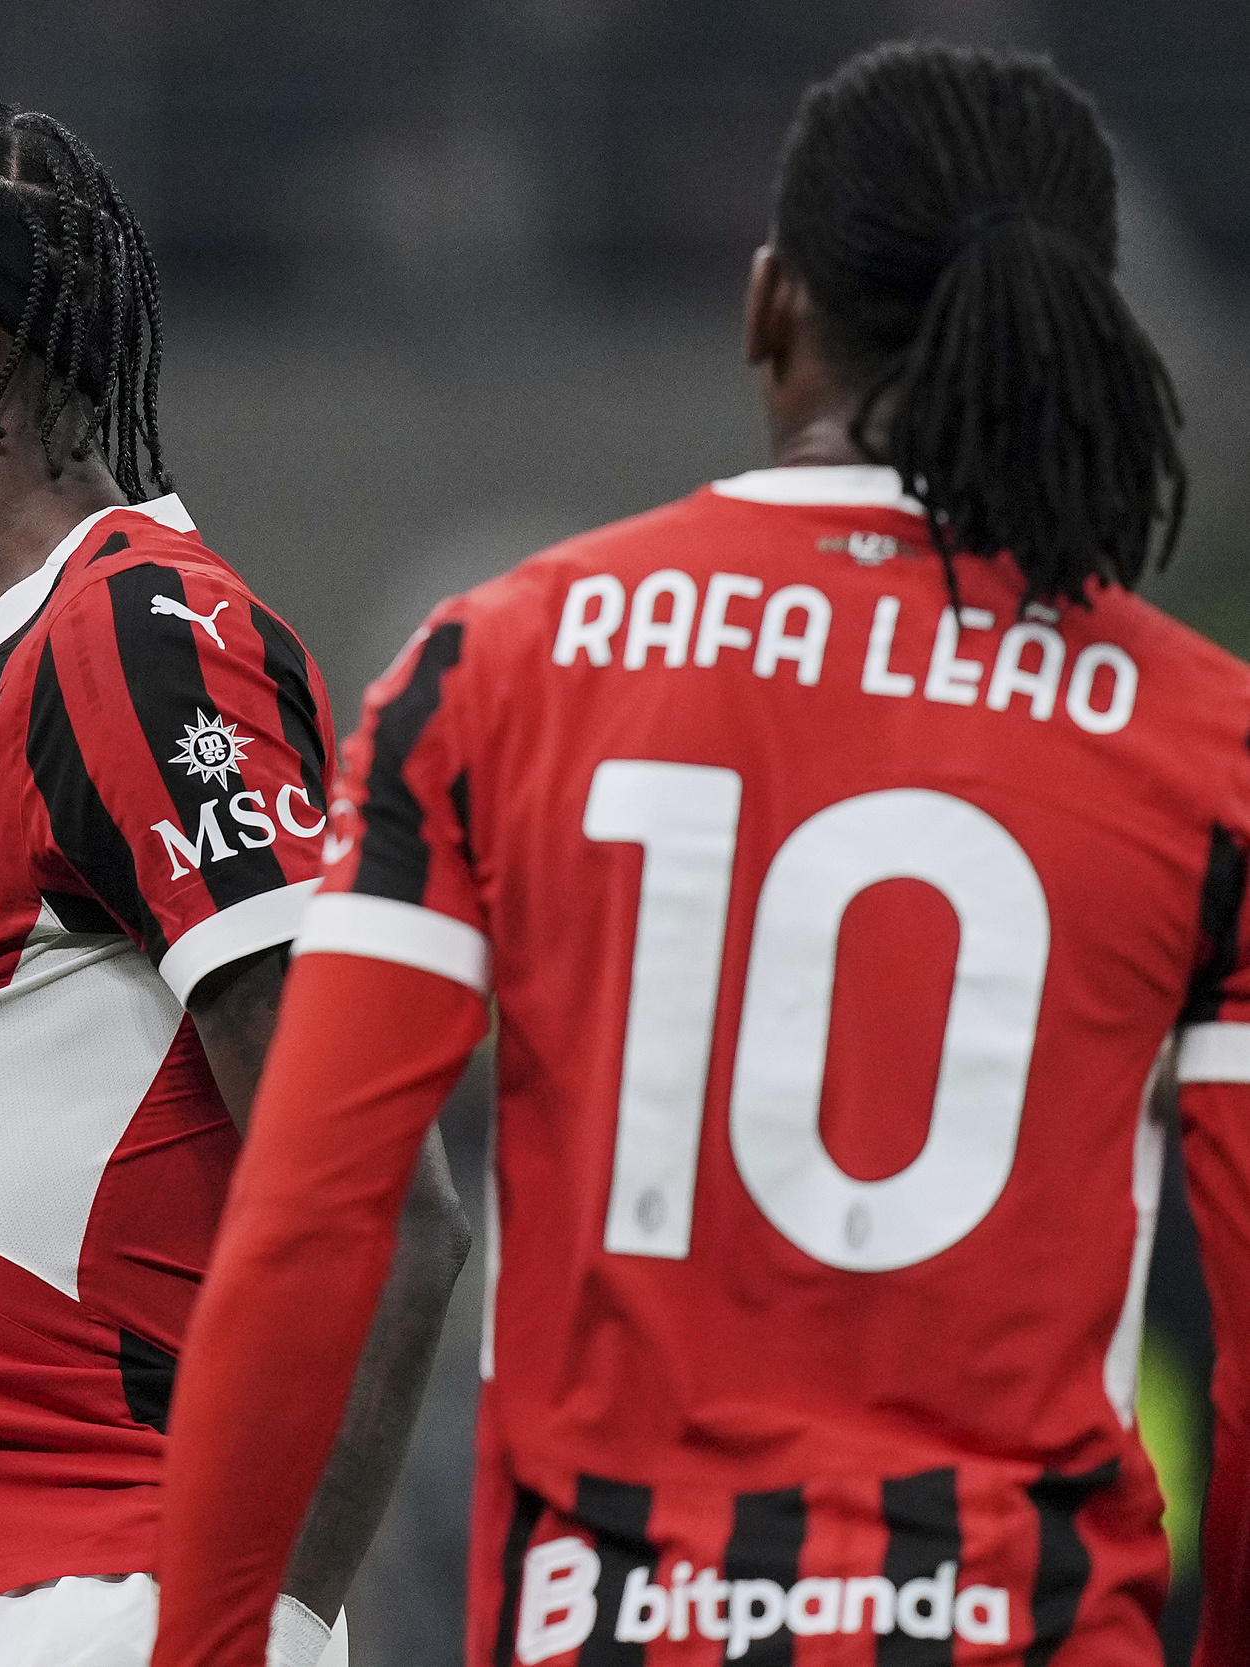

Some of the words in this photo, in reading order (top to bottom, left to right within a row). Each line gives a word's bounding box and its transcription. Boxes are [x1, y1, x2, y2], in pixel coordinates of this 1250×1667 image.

[552, 569, 832, 686] RAFA
[861, 596, 1139, 734] LEÃO
[150, 784, 326, 880] MSC
[582, 758, 1050, 1273] 10
[616, 1561, 1009, 1659] bitpanda
